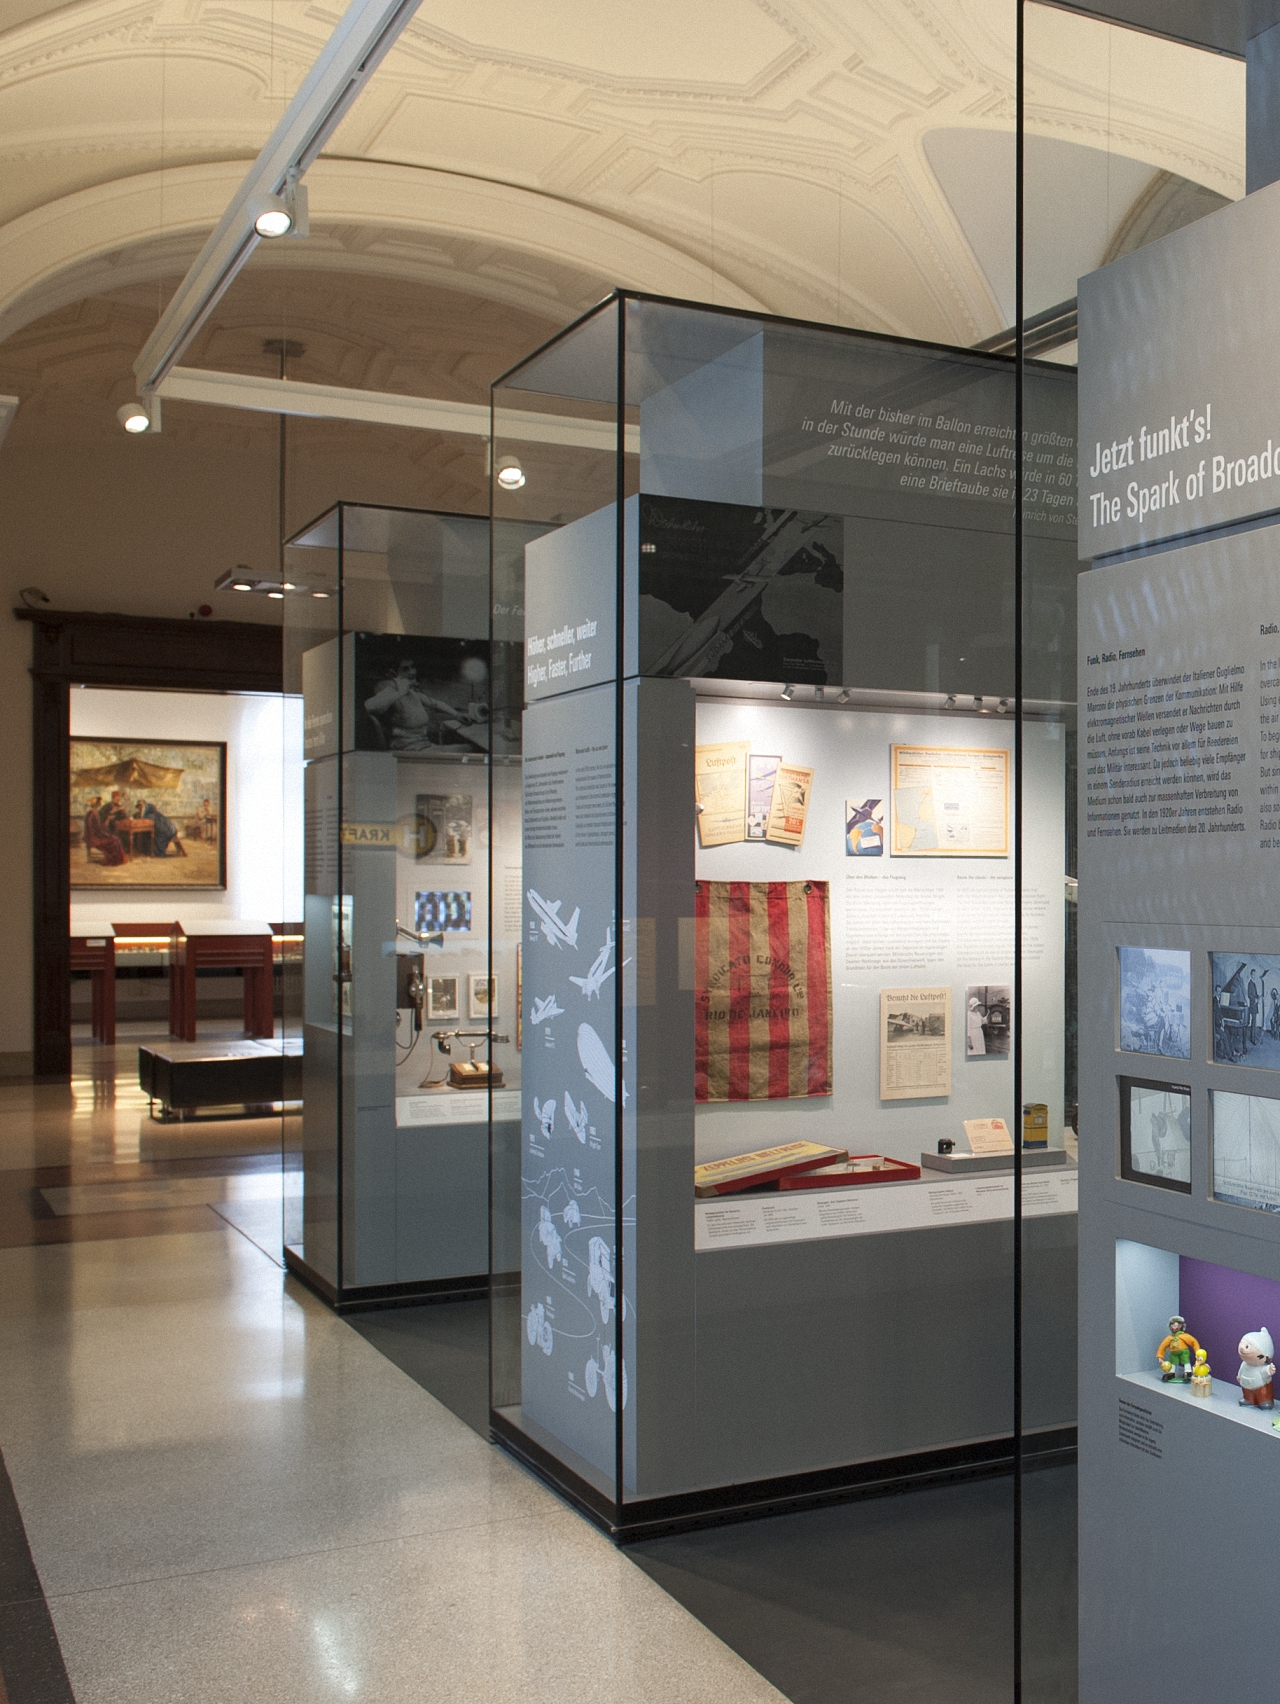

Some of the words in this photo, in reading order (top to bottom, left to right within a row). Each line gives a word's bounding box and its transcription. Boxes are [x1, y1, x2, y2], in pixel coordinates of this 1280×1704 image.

[830, 399, 852, 416] Mit
[854, 403, 876, 419] der
[877, 406, 916, 425] bisher
[917, 412, 932, 428] im
[935, 415, 972, 433] Ballon
[973, 424, 1028, 442] erreichtn
[1030, 430, 1074, 448] größten
[801, 416, 814, 431] in
[816, 419, 839, 434] der
[840, 422, 886, 442] Stunde
[888, 430, 927, 447] würde
[928, 438, 956, 451] man
[957, 439, 983, 456] eine
[1036, 453, 1054, 464] um
[1056, 452, 1074, 468] die
[1089, 435, 1134, 478] Jetzt
[1138, 403, 1211, 462] funkt's!
[826, 444, 901, 466] zurücklegen
[903, 451, 949, 475] können.
[952, 458, 971, 474] Ein
[974, 462, 1007, 479] Lachs
[1010, 468, 1042, 482] wrde
[1044, 470, 1056, 484] in
[1057, 472, 1073, 487] 60
[899, 473, 926, 488] eine
[928, 475, 990, 496] Brieftaube
[992, 485, 1008, 498] sie
[1022, 488, 1038, 502] 23
[1042, 489, 1074, 508] Tagen
[1089, 491, 1121, 527] The
[1126, 470, 1180, 520] Spark
[1185, 462, 1205, 500] of
[577, 618, 598, 640] weiter
[1260, 622, 1279, 635] Radio,
[568, 650, 592, 674] Further
[1086, 654, 1100, 665] Funk,
[1101, 652, 1117, 663] Radio,
[1118, 648, 1146, 660] Fernsehen
[1267, 658, 1277, 670] the
[1259, 695, 1277, 707] Using
[1259, 838, 1271, 849] and
[920, 992, 946, 1002] Luftpost!
[706, 1010, 726, 1020] RIO
[730, 1009, 744, 1020] DE
[748, 1008, 800, 1020] JANEIRO
